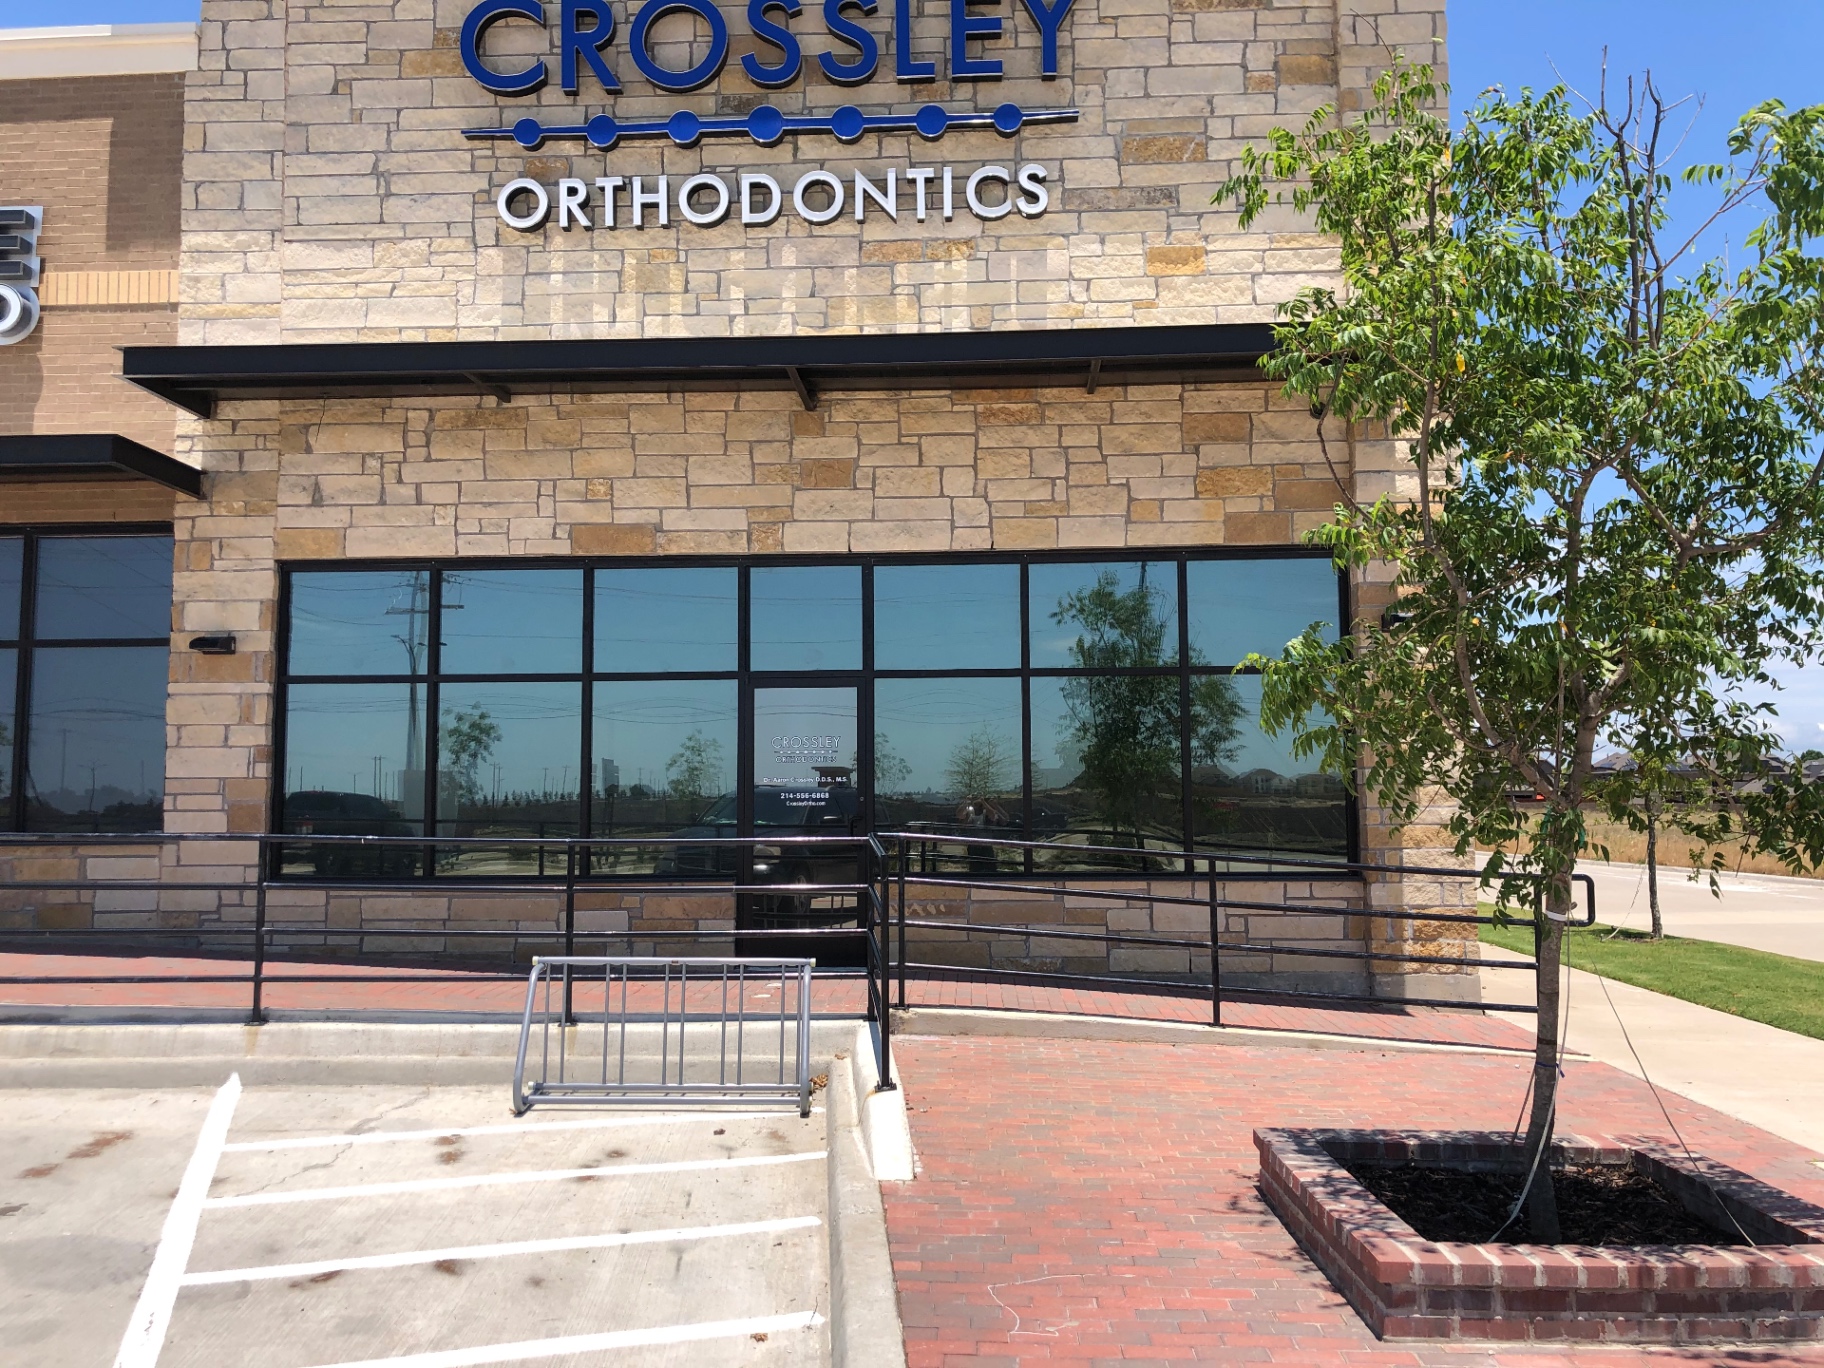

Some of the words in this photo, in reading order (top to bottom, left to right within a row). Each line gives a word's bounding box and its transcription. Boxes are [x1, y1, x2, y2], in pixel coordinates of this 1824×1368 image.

[459, 0, 1075, 95] CROSSLEY
[497, 163, 1049, 231] ORTHODONTICS
[771, 735, 841, 749] CROSSLEY
[775, 755, 837, 764] ORTHODONTICS
[790, 776, 814, 784] Crossley
